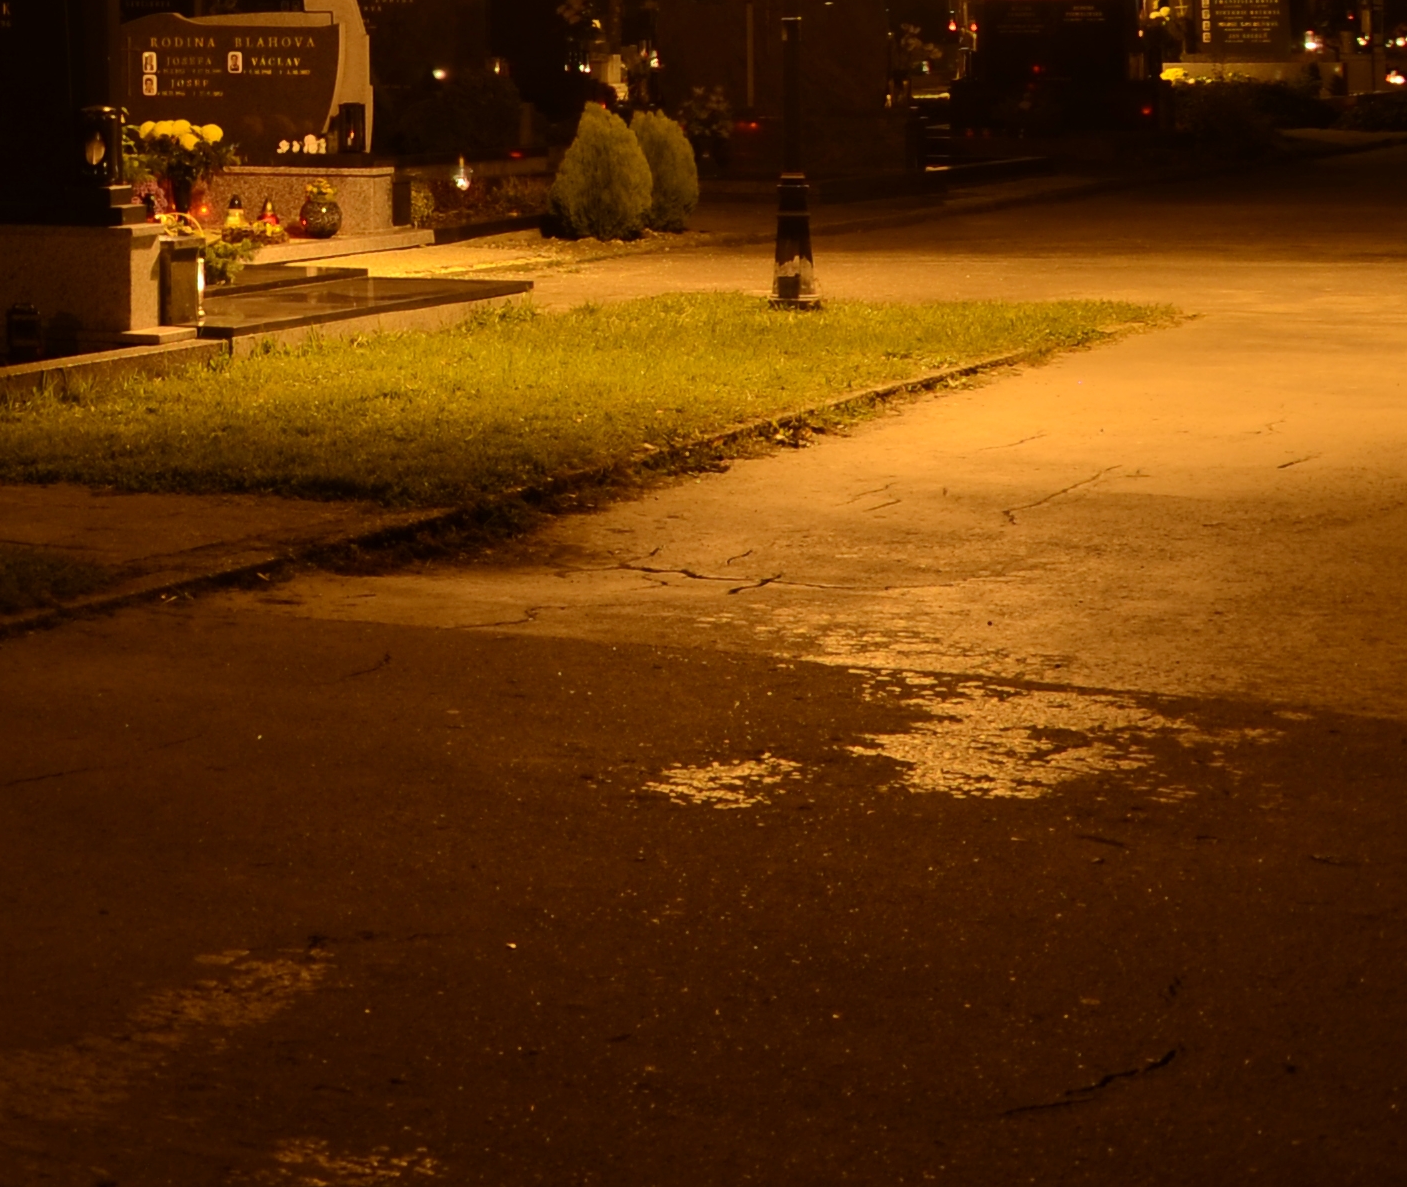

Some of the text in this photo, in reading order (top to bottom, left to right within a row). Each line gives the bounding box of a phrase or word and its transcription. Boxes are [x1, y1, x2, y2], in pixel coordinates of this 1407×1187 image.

[149, 36, 215, 48] RODINA
[167, 54, 301, 67] JOSEFA VÁCLAV
